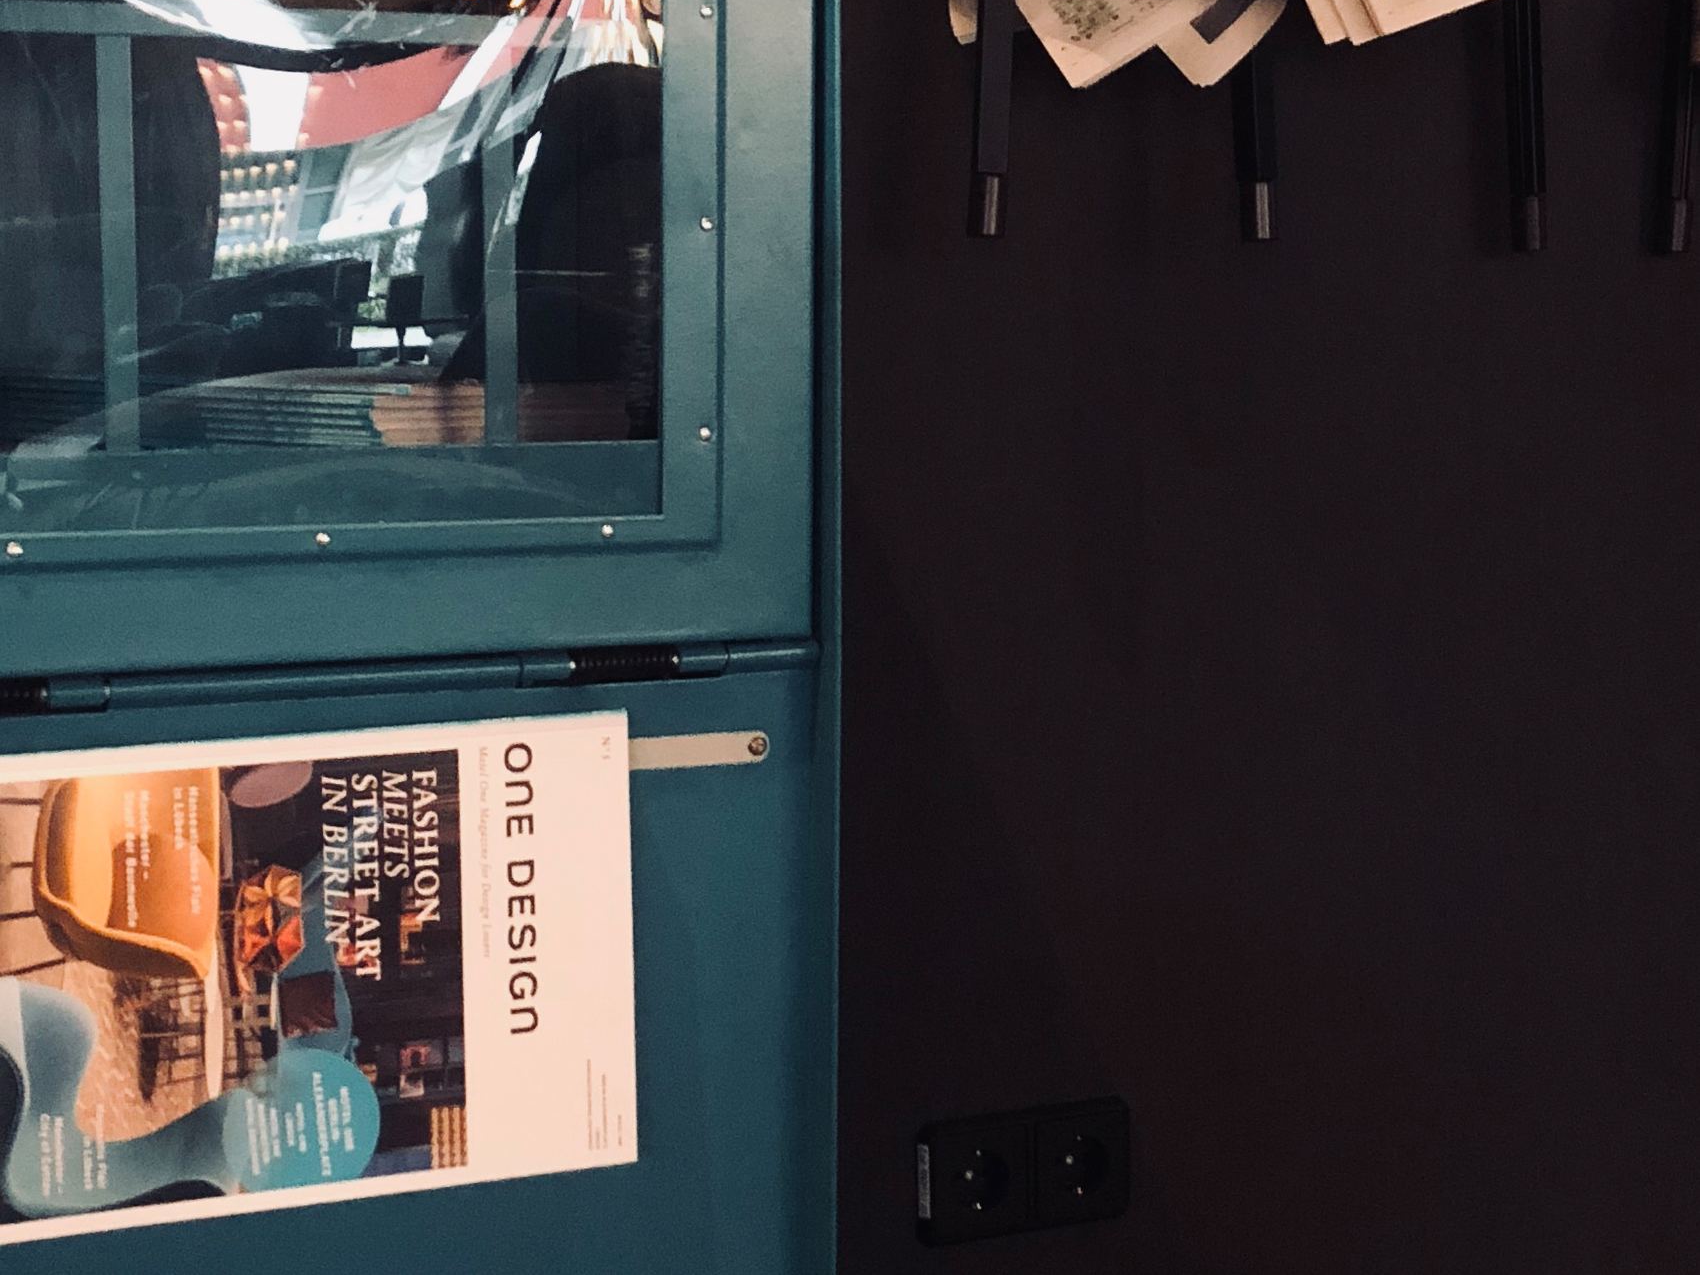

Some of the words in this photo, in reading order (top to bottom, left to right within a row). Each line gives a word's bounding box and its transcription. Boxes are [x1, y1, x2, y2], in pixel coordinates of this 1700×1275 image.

[321, 775, 347, 812] IN
[351, 773, 380, 902] STREET
[382, 770, 410, 878] MEETS
[412, 768, 440, 922] FASHION
[322, 824, 350, 944] BERLIN
[355, 914, 381, 981] ART
